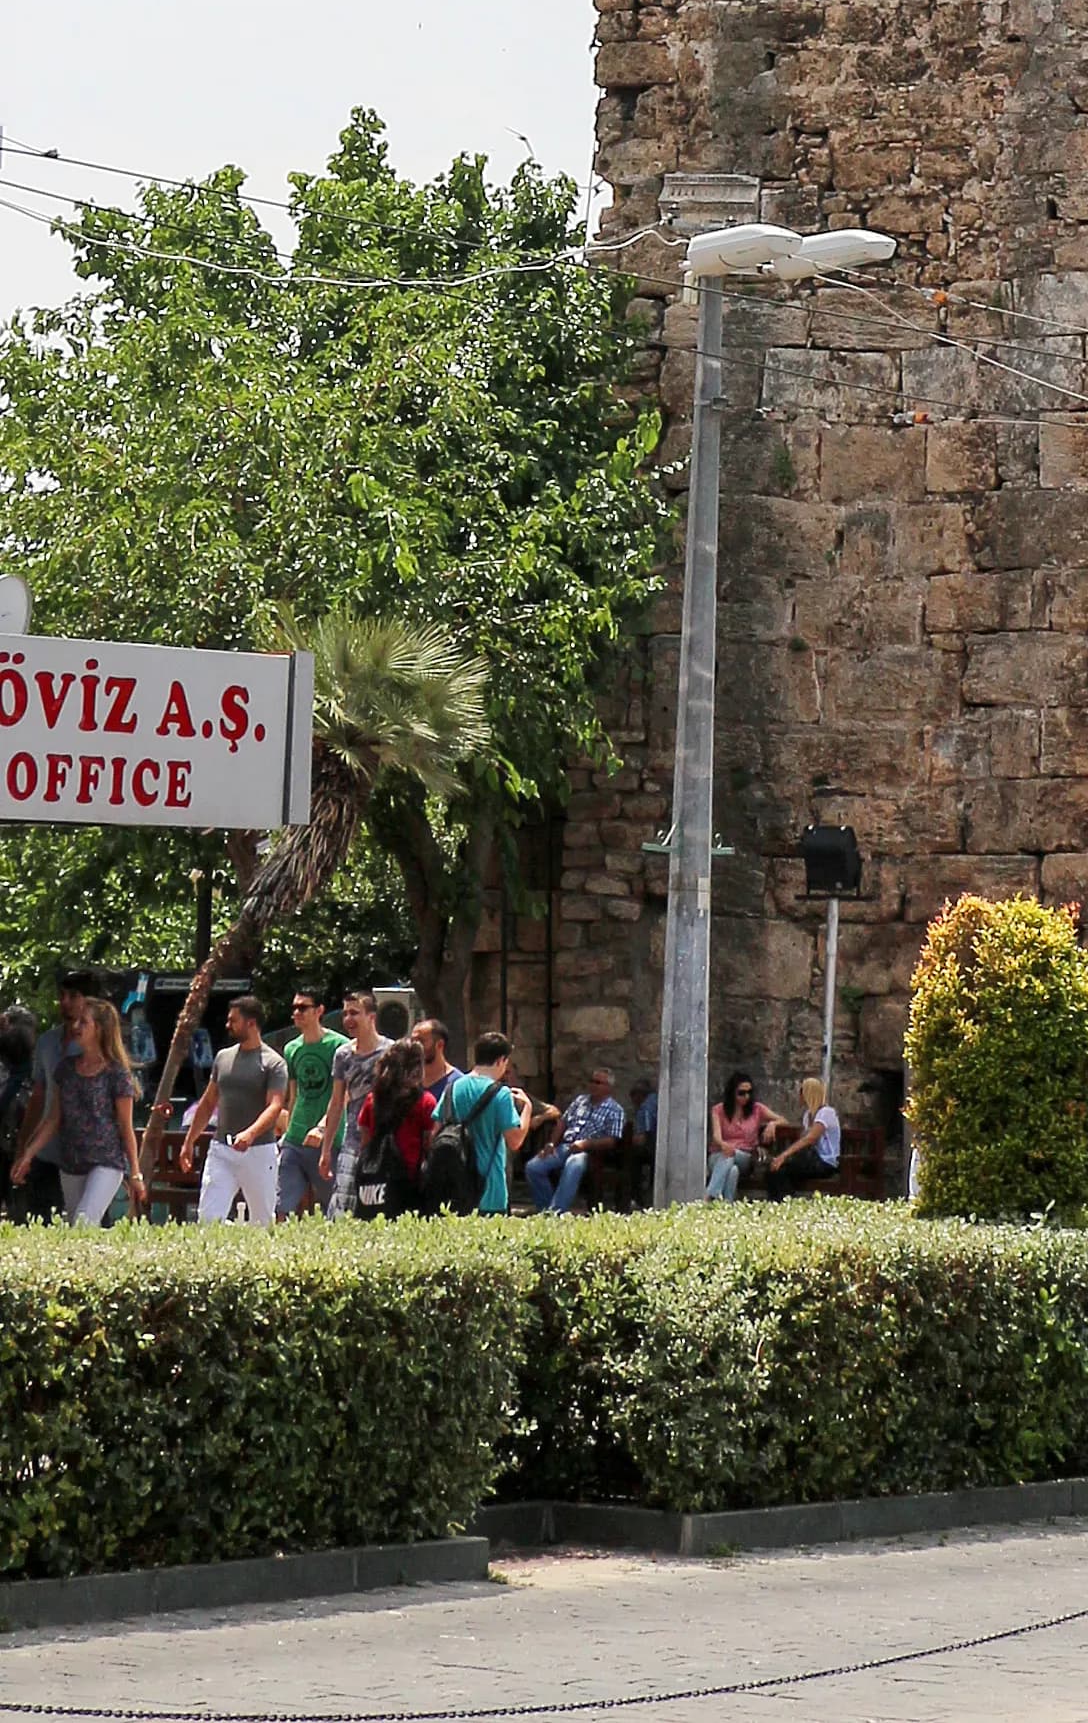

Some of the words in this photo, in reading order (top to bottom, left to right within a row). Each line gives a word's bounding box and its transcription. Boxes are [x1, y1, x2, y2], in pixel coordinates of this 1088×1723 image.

[156, 680, 266, 753] A.Ş.
[7, 752, 192, 808] OFFICE
[359, 1183, 387, 1206] NIKE
